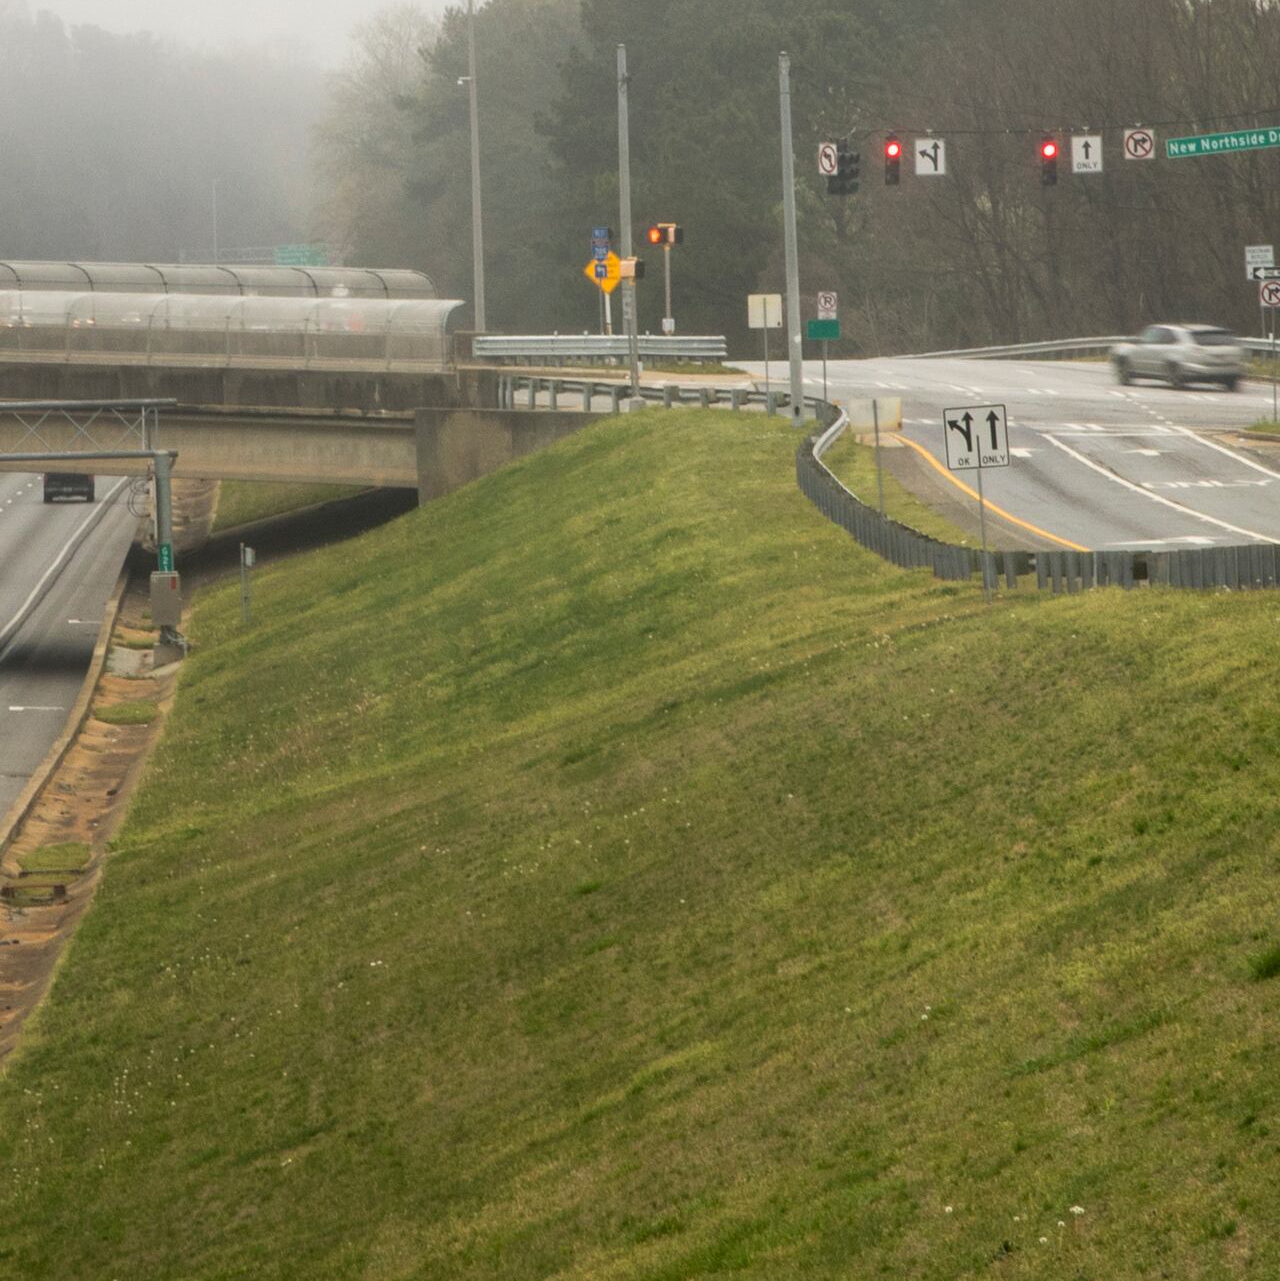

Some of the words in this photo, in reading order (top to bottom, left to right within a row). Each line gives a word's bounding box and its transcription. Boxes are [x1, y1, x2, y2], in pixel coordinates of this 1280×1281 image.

[1169, 141, 1197, 155] New
[1200, 133, 1265, 151] Northside
[1076, 161, 1098, 170] ONLY
[958, 458, 970, 466] OK
[982, 455, 1006, 465] ONLY
[1138, 478, 1274, 489] ONLY
